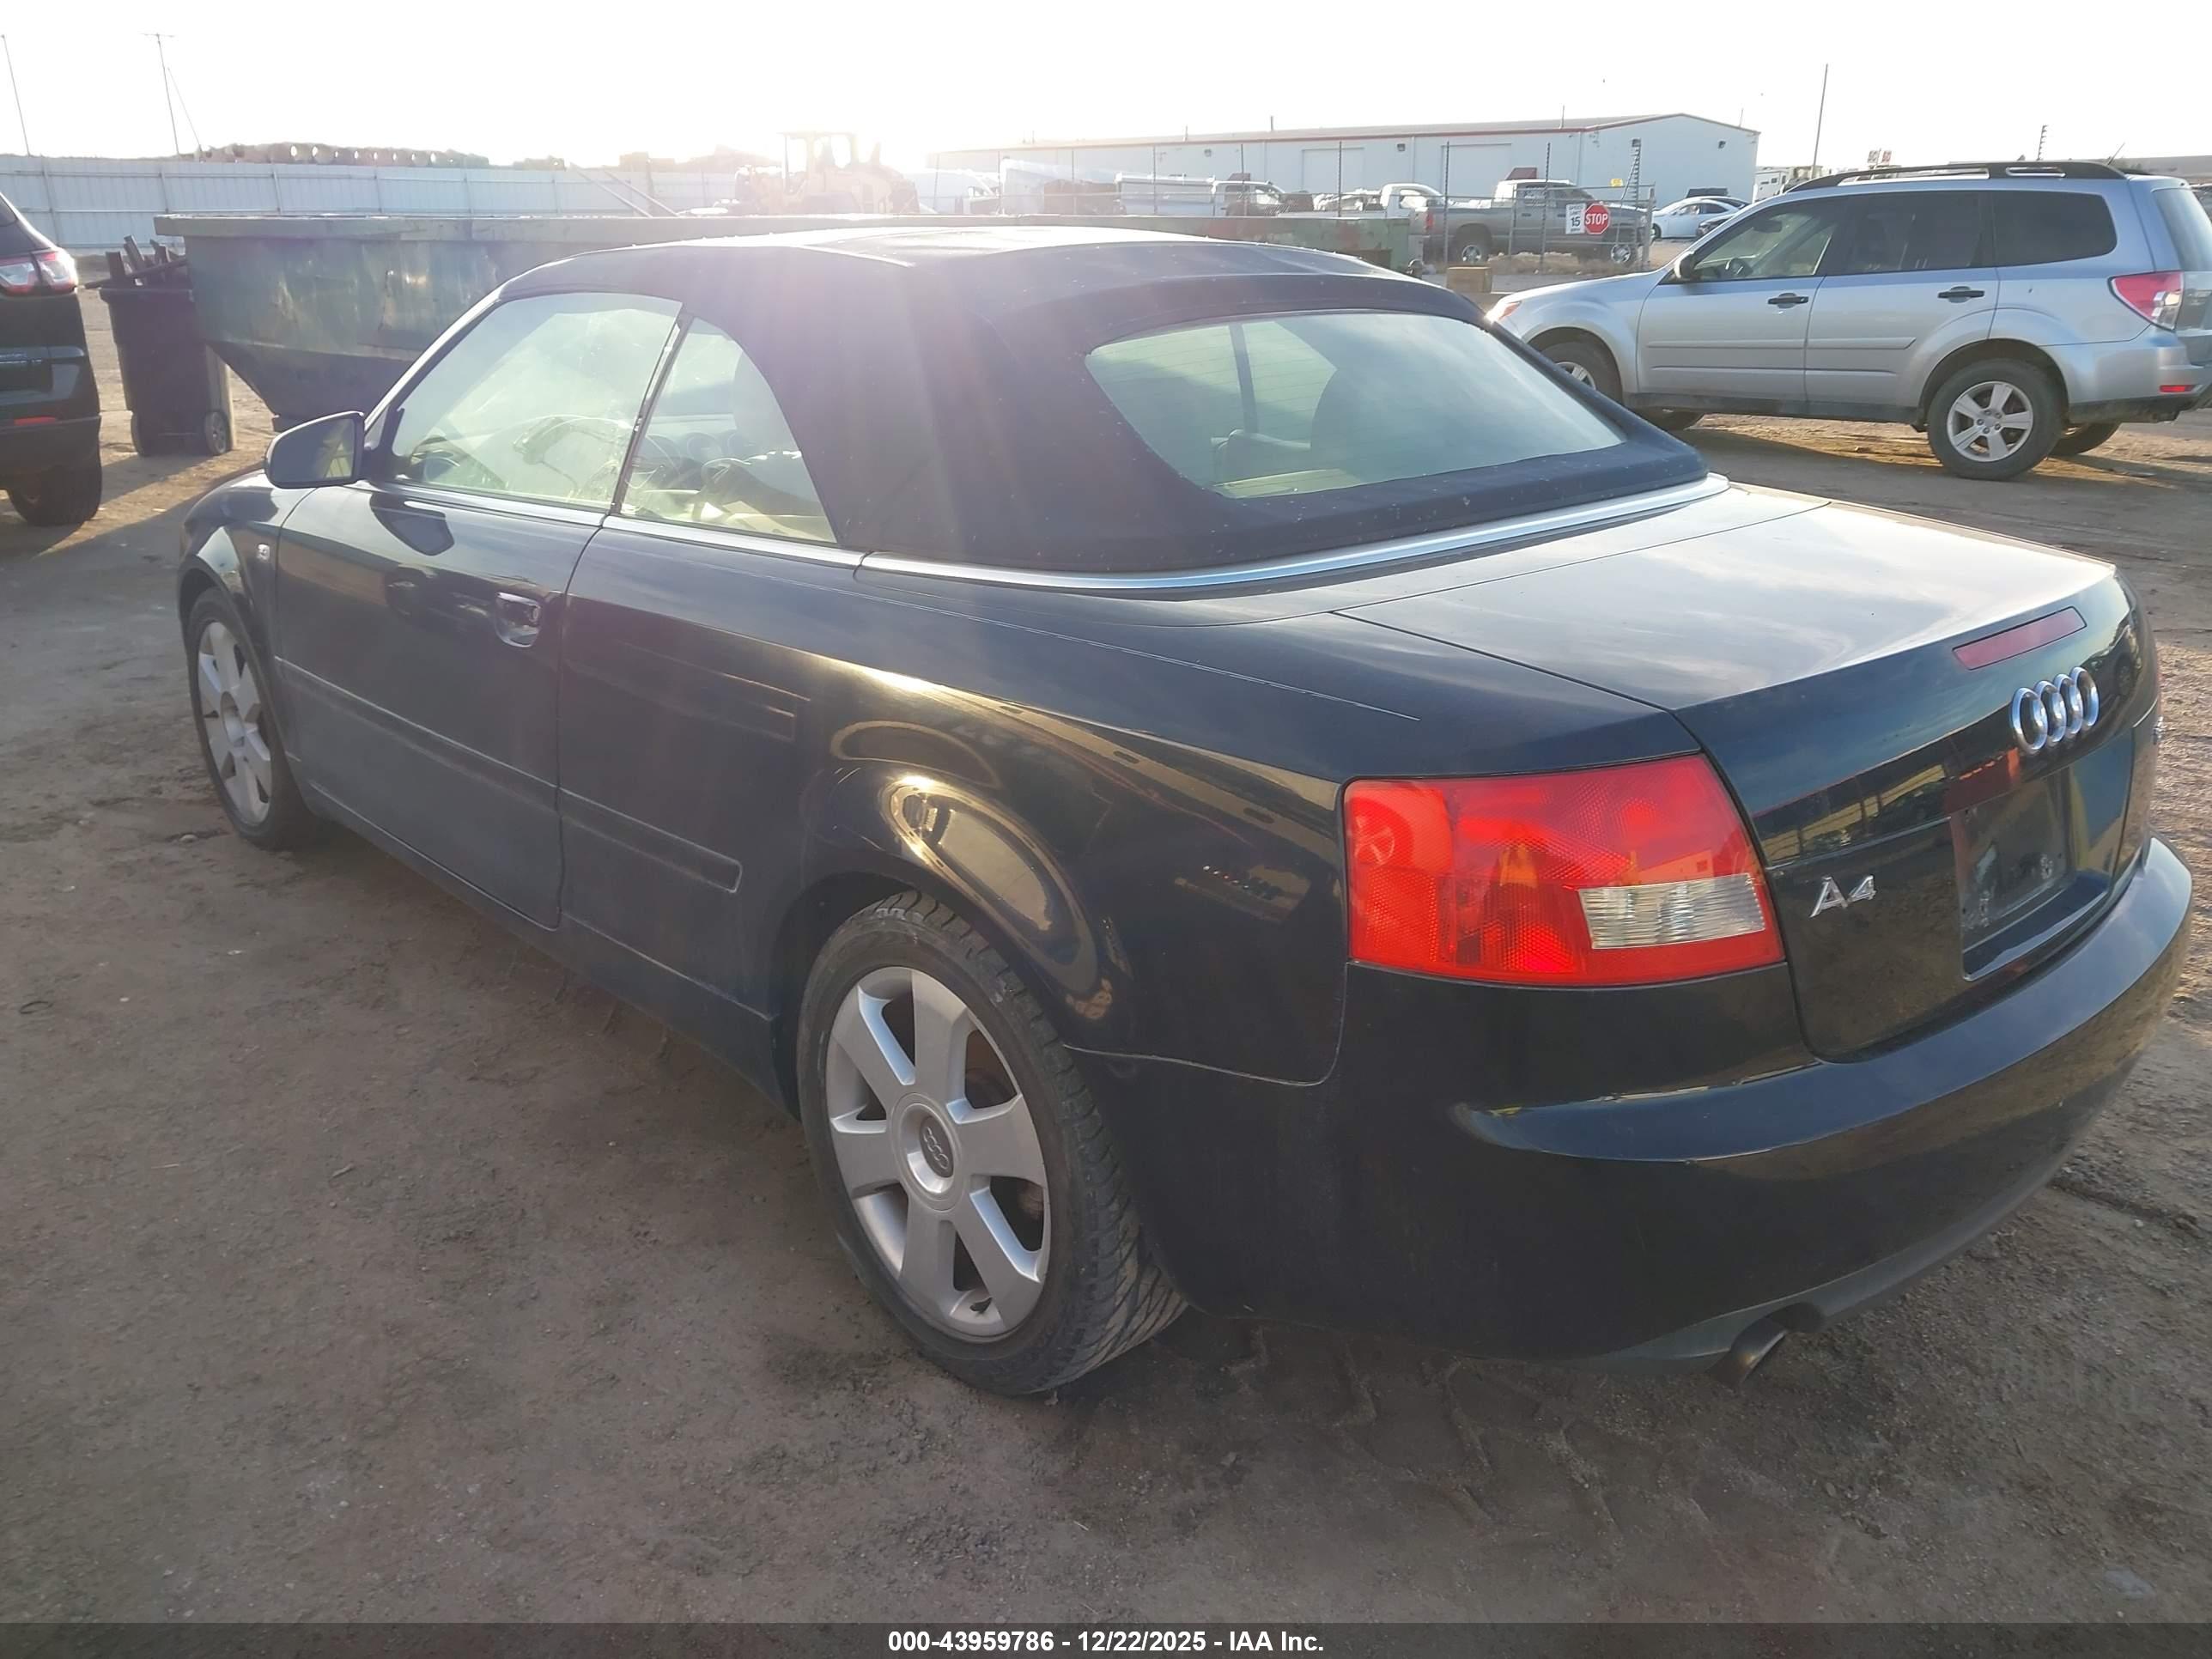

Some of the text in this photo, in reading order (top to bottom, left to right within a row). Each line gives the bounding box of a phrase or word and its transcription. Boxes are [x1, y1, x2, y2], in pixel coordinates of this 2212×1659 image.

[1571, 216, 1581, 227] 15
[1585, 213, 1608, 225] STOP
[1809, 875, 1876, 918] A4
